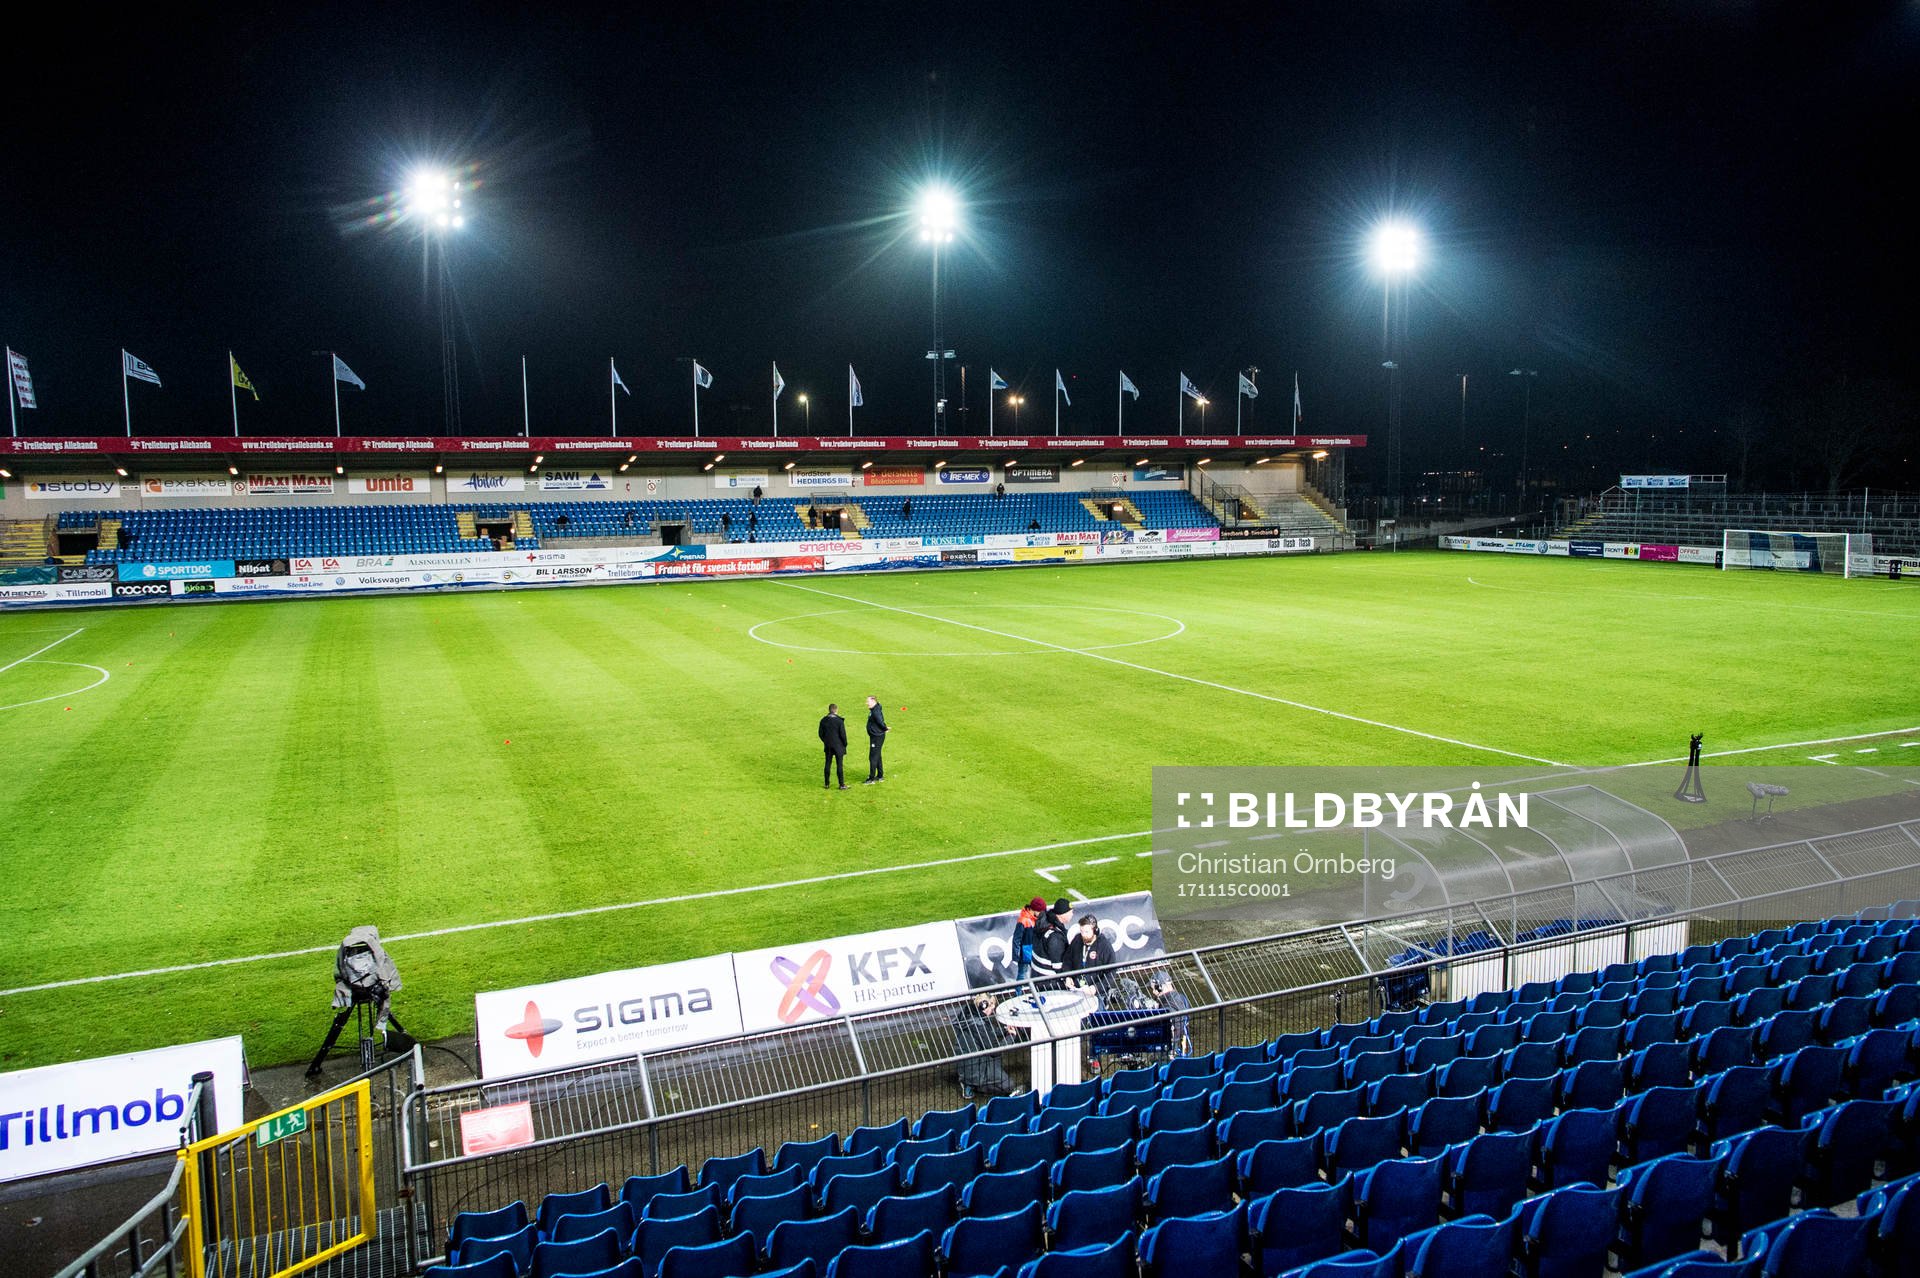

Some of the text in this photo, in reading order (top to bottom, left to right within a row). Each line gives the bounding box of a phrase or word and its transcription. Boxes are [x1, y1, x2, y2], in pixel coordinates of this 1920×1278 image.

[24, 441, 98, 451] Trelleborgs Allehanda
[141, 441, 212, 450] Trelleborgs Allehanda
[243, 441, 333, 450] www.trelleborgsallehanda.se
[372, 441, 434, 450] Trelleborgs Allehanda
[471, 441, 530, 450] Trelleborgs Allehanda
[556, 441, 632, 449] www.trelleborgsallehanda.se
[665, 441, 692, 449] Trelleborgs
[748, 441, 775, 449] Trelleborgs
[913, 440, 937, 448] Trelleborgs
[545, 472, 580, 481] SAWI
[1012, 469, 1053, 477] OPTIMERA
[164, 478, 227, 487] exakta
[249, 475, 289, 486] MAXI
[292, 474, 331, 486] MAXI
[366, 474, 414, 491] umia
[48, 480, 114, 494] stoby
[1057, 533, 1077, 541] MAXI
[1079, 532, 1099, 540] MAXI
[800, 541, 862, 553] smarteyes
[356, 559, 382, 567] BRA
[658, 560, 770, 574] Framåt för svensk fotboll!
[158, 565, 212, 575] SPORTDOC
[552, 567, 592, 575] LARSSON
[608, 568, 643, 577] Trelleborg
[358, 576, 410, 584] Volkswagen
[65, 589, 107, 597] Tillmobil
[847, 943, 932, 986] KFX
[853, 980, 936, 1003] HR-partner
[576, 1036, 608, 1050] Expect
[618, 1030, 644, 1043] better
[645, 1023, 689, 1038] tomorrow
